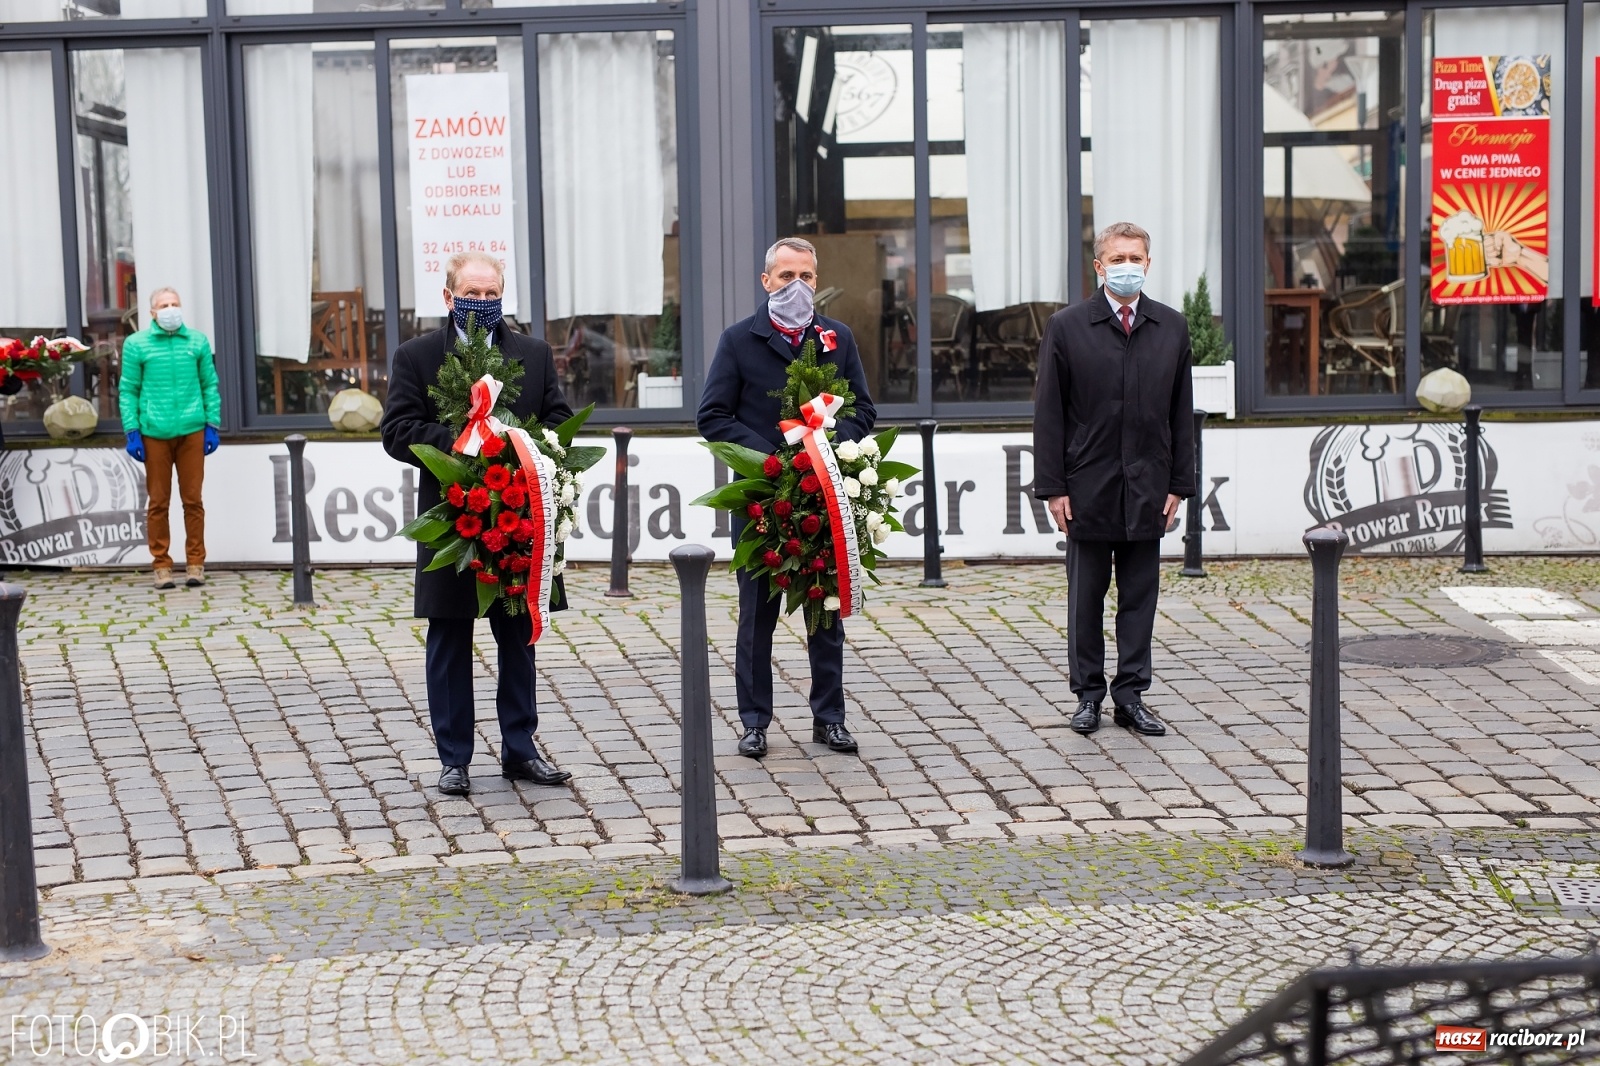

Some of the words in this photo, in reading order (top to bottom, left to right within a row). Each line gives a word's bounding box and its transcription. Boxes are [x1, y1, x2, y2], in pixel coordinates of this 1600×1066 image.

[1435, 60, 1457, 74] Pizza
[1459, 59, 1484, 73] Time
[1434, 78, 1463, 92] Druga
[1464, 78, 1487, 92] pizza
[1447, 91, 1481, 111] gratis!
[415, 112, 506, 138] ZAMÓW
[1449, 123, 1536, 151] Promocja
[418, 148, 427, 160] Z
[431, 146, 505, 160] DOWOZEM
[1461, 154, 1488, 166] DWA
[1491, 153, 1521, 165] PIWA
[447, 166, 477, 179] LUB
[1440, 168, 1452, 180] W
[1454, 168, 1488, 179] CENIE
[1489, 166, 1541, 178] JEDNEGO
[424, 184, 501, 199] ODBIOREM
[425, 205, 438, 217] W
[443, 203, 501, 217] LOKALU
[423, 242, 438, 254] 32
[443, 241, 464, 253] 415
[469, 240, 485, 252] 84
[490, 240, 506, 252] 84
[425, 261, 440, 273] 32
[269, 453, 686, 554] Restcja
[823, 462, 854, 545] PREZYDENTA
[0, 530, 74, 564] Browar
[77, 512, 145, 549] Rynek
[1406, 536, 1437, 553] 2013
[71, 552, 98, 565] 2013
